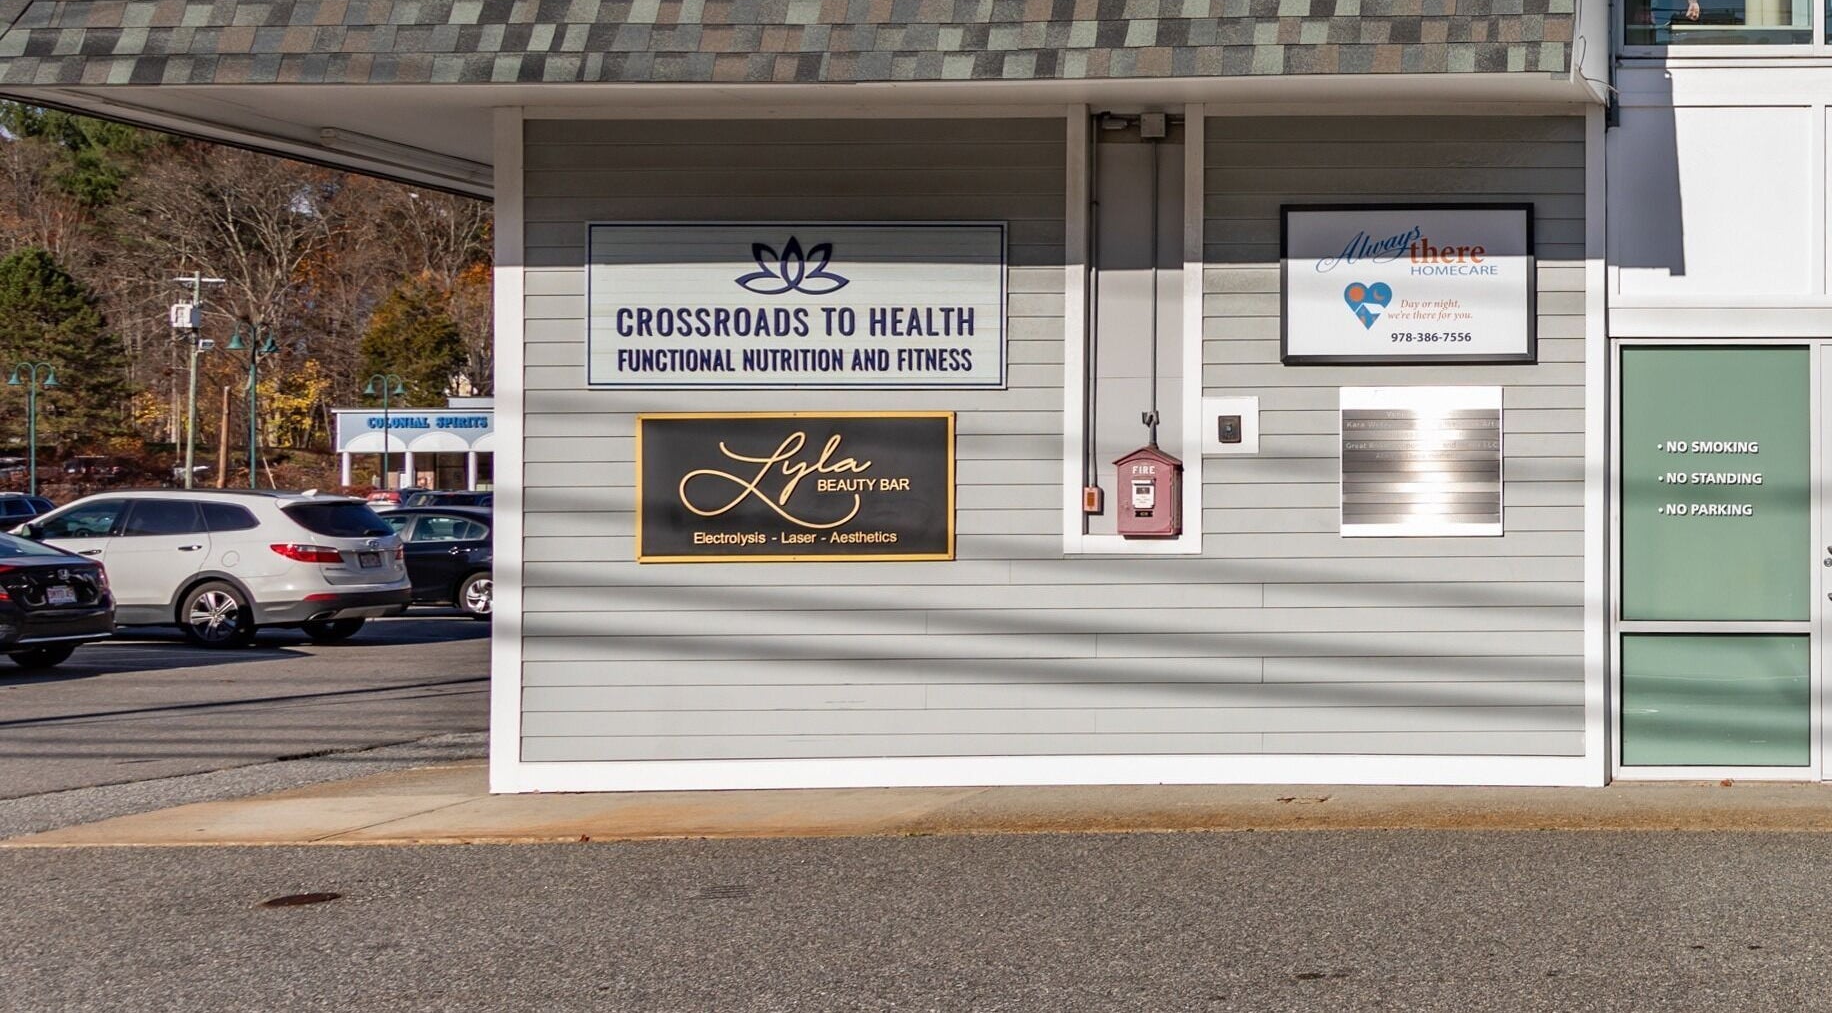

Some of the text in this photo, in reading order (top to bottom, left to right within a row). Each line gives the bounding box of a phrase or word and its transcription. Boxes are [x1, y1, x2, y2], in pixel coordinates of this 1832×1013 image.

[1315, 225, 1486, 273] Always there
[1410, 265, 1499, 276] HOMECARE
[1400, 299, 1420, 309] Day
[1433, 299, 1461, 309] night,
[615, 306, 975, 337] CROSSROADS TO HEALTH
[1387, 310, 1473, 321] we're there for you.
[1390, 332, 1473, 342] 978-386-7556
[617, 348, 973, 372] FUNCTIONAL NUTRITION AND FITNESS
[367, 416, 489, 428] COLONIAL SPIRITS
[1666, 441, 1760, 454] NO SMOKING
[1132, 465, 1156, 475] FIRE
[679, 431, 872, 529] Lyla
[817, 478, 911, 492] BEAUTY BAR
[1666, 472, 1763, 485] NO STANDING
[1666, 503, 1753, 516] NO PARKING
[693, 532, 767, 546] Electrolysis
[781, 532, 817, 544] Laser
[830, 531, 898, 544] Aesthetics
